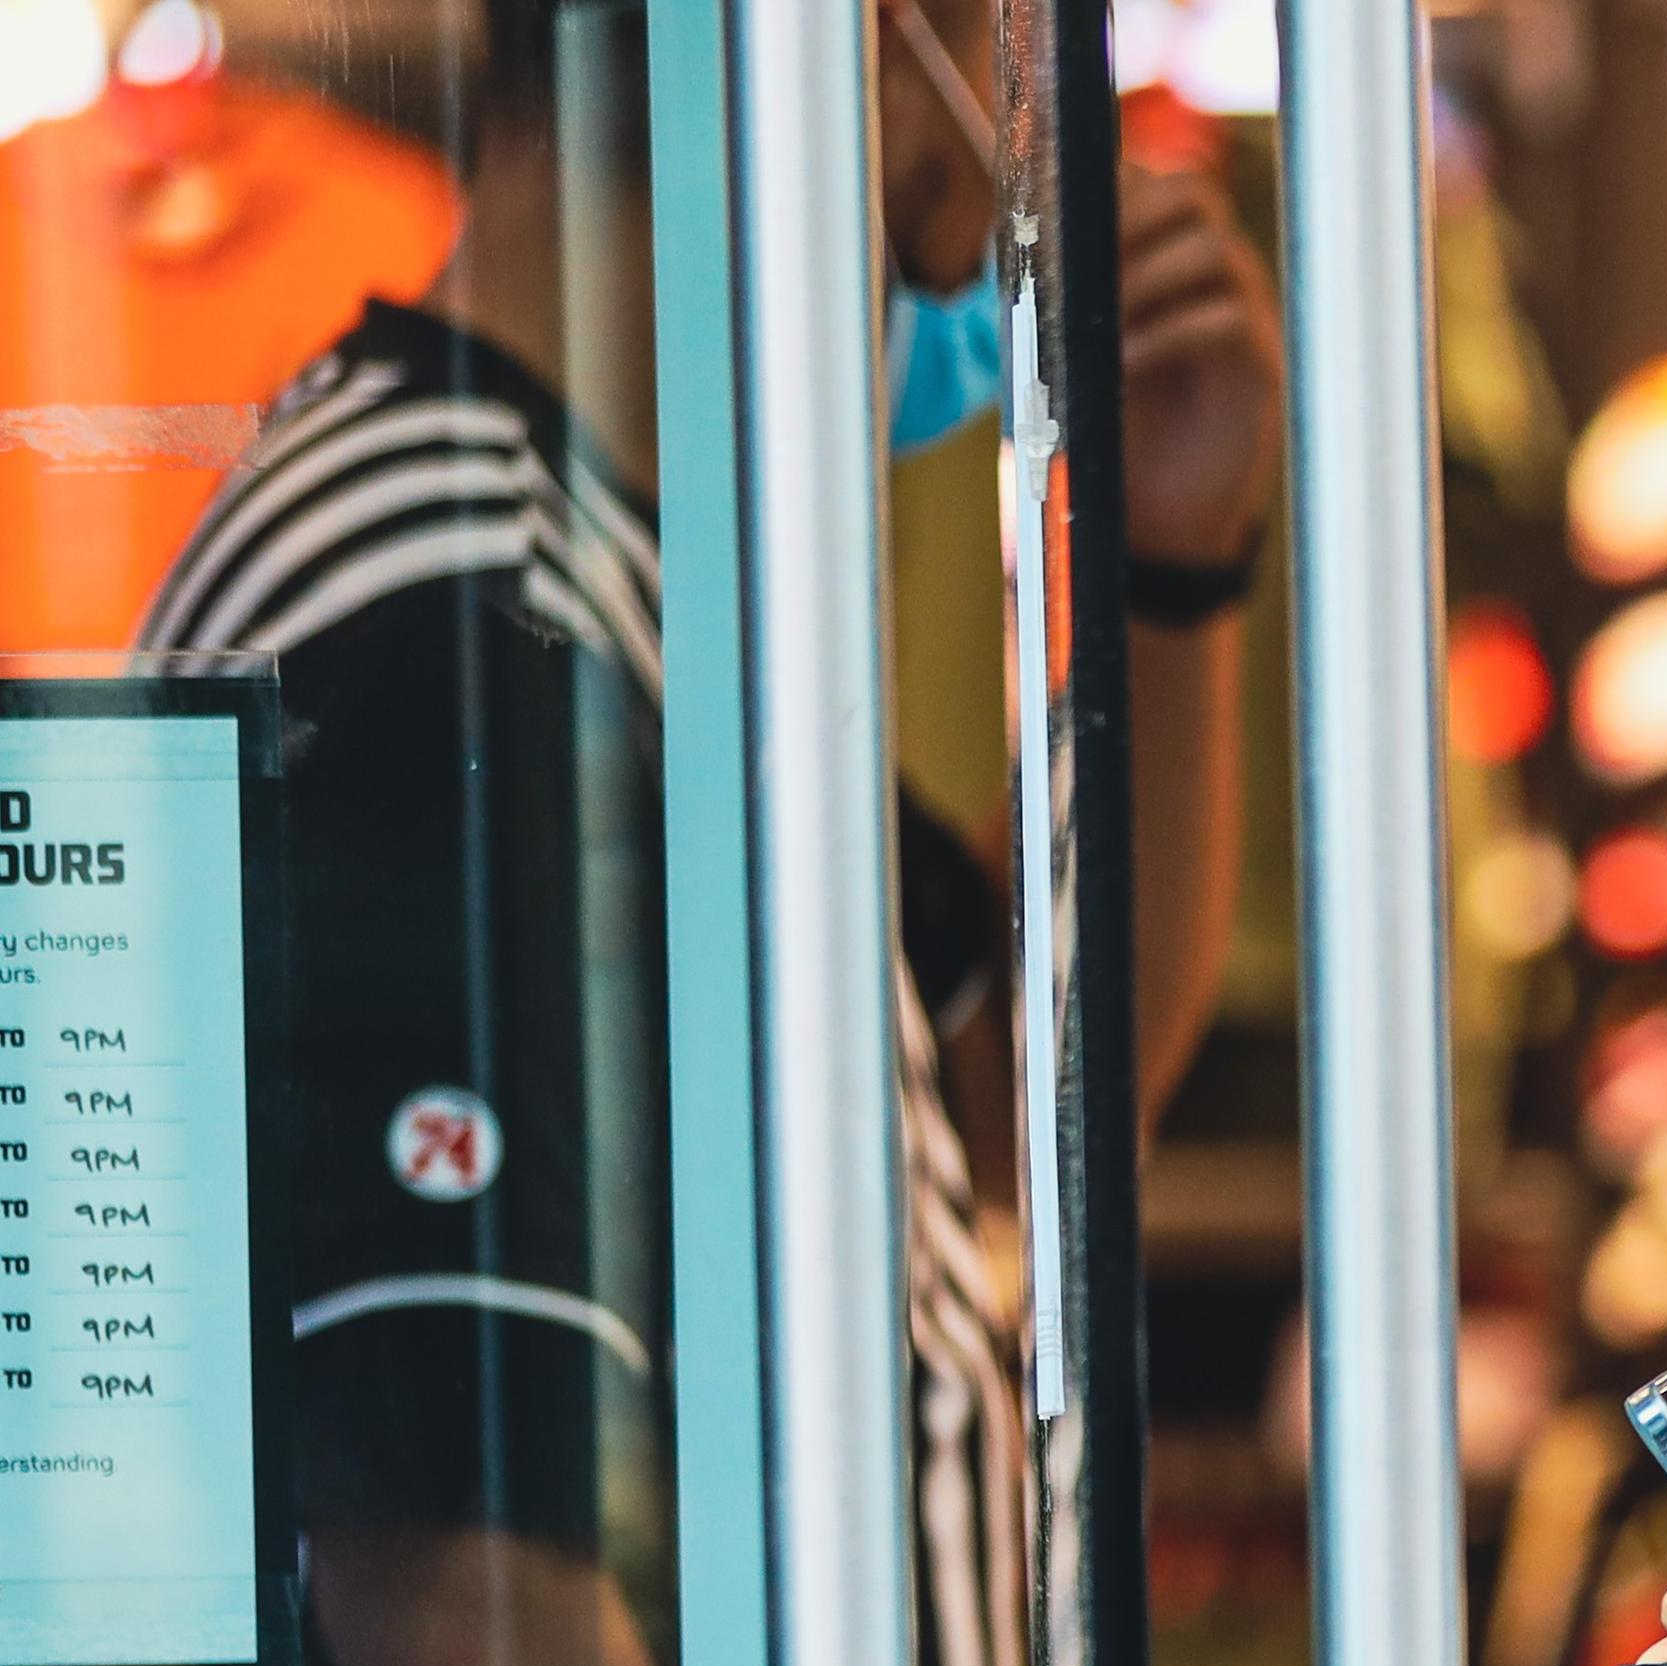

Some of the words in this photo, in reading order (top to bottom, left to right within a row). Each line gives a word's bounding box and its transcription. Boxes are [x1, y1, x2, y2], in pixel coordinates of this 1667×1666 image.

[24, 928, 128, 957] changes
[0, 1028, 25, 1048] TO
[0, 1085, 26, 1104] TO
[0, 1142, 27, 1162] TO
[0, 1198, 28, 1218] TO
[1, 1255, 30, 1275] TO
[2, 1312, 31, 1332] TO
[3, 1369, 32, 1389] TO
